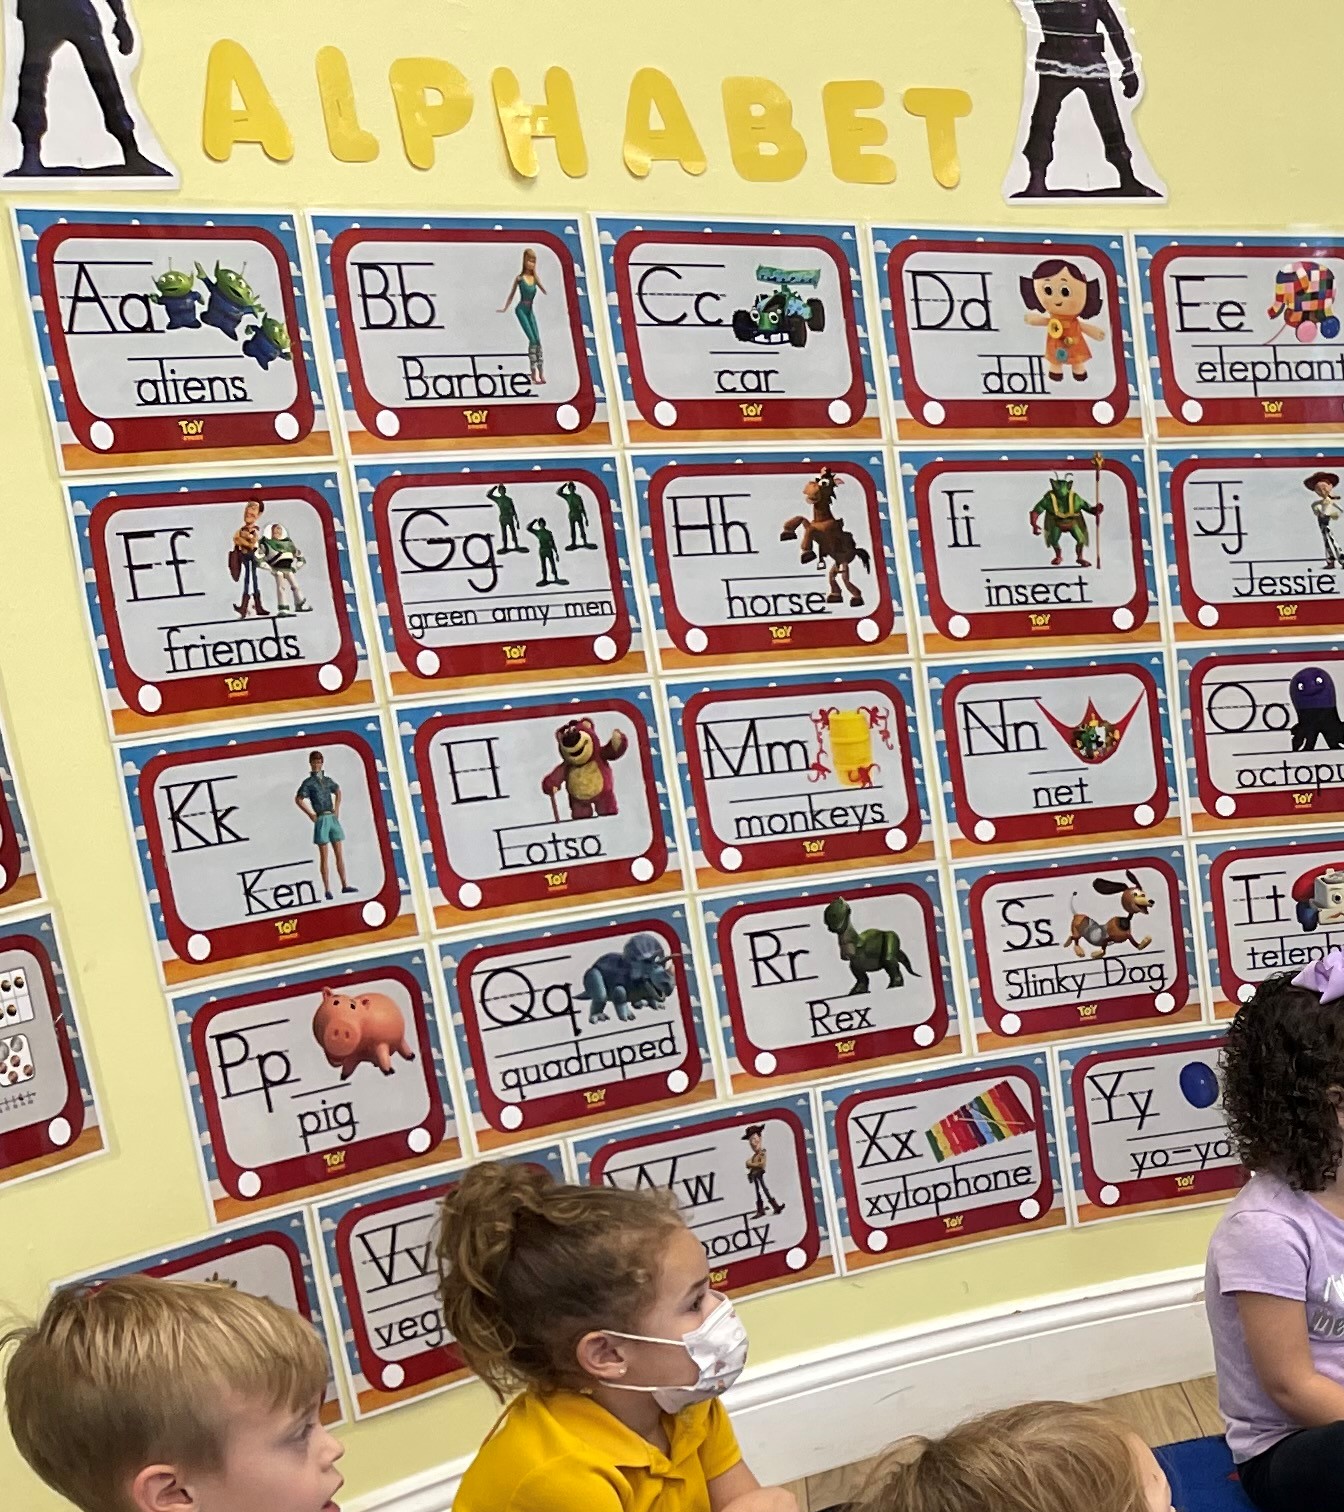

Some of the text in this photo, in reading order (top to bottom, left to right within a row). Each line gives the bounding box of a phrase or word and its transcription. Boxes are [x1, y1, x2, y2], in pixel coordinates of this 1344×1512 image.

[202, 38, 974, 189] ALPHABET
[63, 262, 157, 334] Aa
[357, 264, 437, 329] Bb
[636, 265, 725, 327] Cc
[911, 273, 994, 331] Dd
[1177, 277, 1246, 331] Ee
[136, 359, 250, 406] aliens
[403, 357, 532, 400] Barbie
[715, 367, 779, 394] car
[982, 355, 1047, 394] doll
[677, 496, 751, 556] Hh
[948, 490, 979, 549] Ii
[1195, 481, 1246, 555] Jj
[123, 530, 191, 600] Ff
[399, 509, 498, 592] Gg
[727, 577, 826, 619] horse
[985, 574, 1089, 606] insect
[1233, 561, 1337, 597] Jessie
[407, 597, 613, 637] green army men
[163, 618, 302, 672] friends
[964, 700, 1043, 757] Nn
[1208, 684, 1289, 735] Oo
[446, 738, 504, 806] Ll
[703, 716, 811, 780] Mm
[163, 780, 242, 852] Kk
[735, 789, 887, 840] monkeys
[1032, 778, 1090, 808] net
[496, 826, 603, 871] Lotso
[240, 867, 317, 916] Ken
[1231, 874, 1287, 924] Tt
[1002, 900, 1054, 950] Ss
[749, 930, 816, 986] Rr
[1006, 957, 1165, 1000] Slinky Dog
[479, 968, 581, 1034] Qq
[809, 1000, 872, 1037] Rex
[214, 1031, 292, 1112] Pp
[501, 1023, 677, 1098] quadruped
[299, 1099, 357, 1152] pig
[1088, 1071, 1153, 1131] Yy
[853, 1115, 919, 1168] Xx
[1131, 1140, 1231, 1178] yo-yo
[867, 1160, 1035, 1219] xylophone
[359, 1225, 432, 1286] Vv
[700, 1213, 770, 1255] ody
